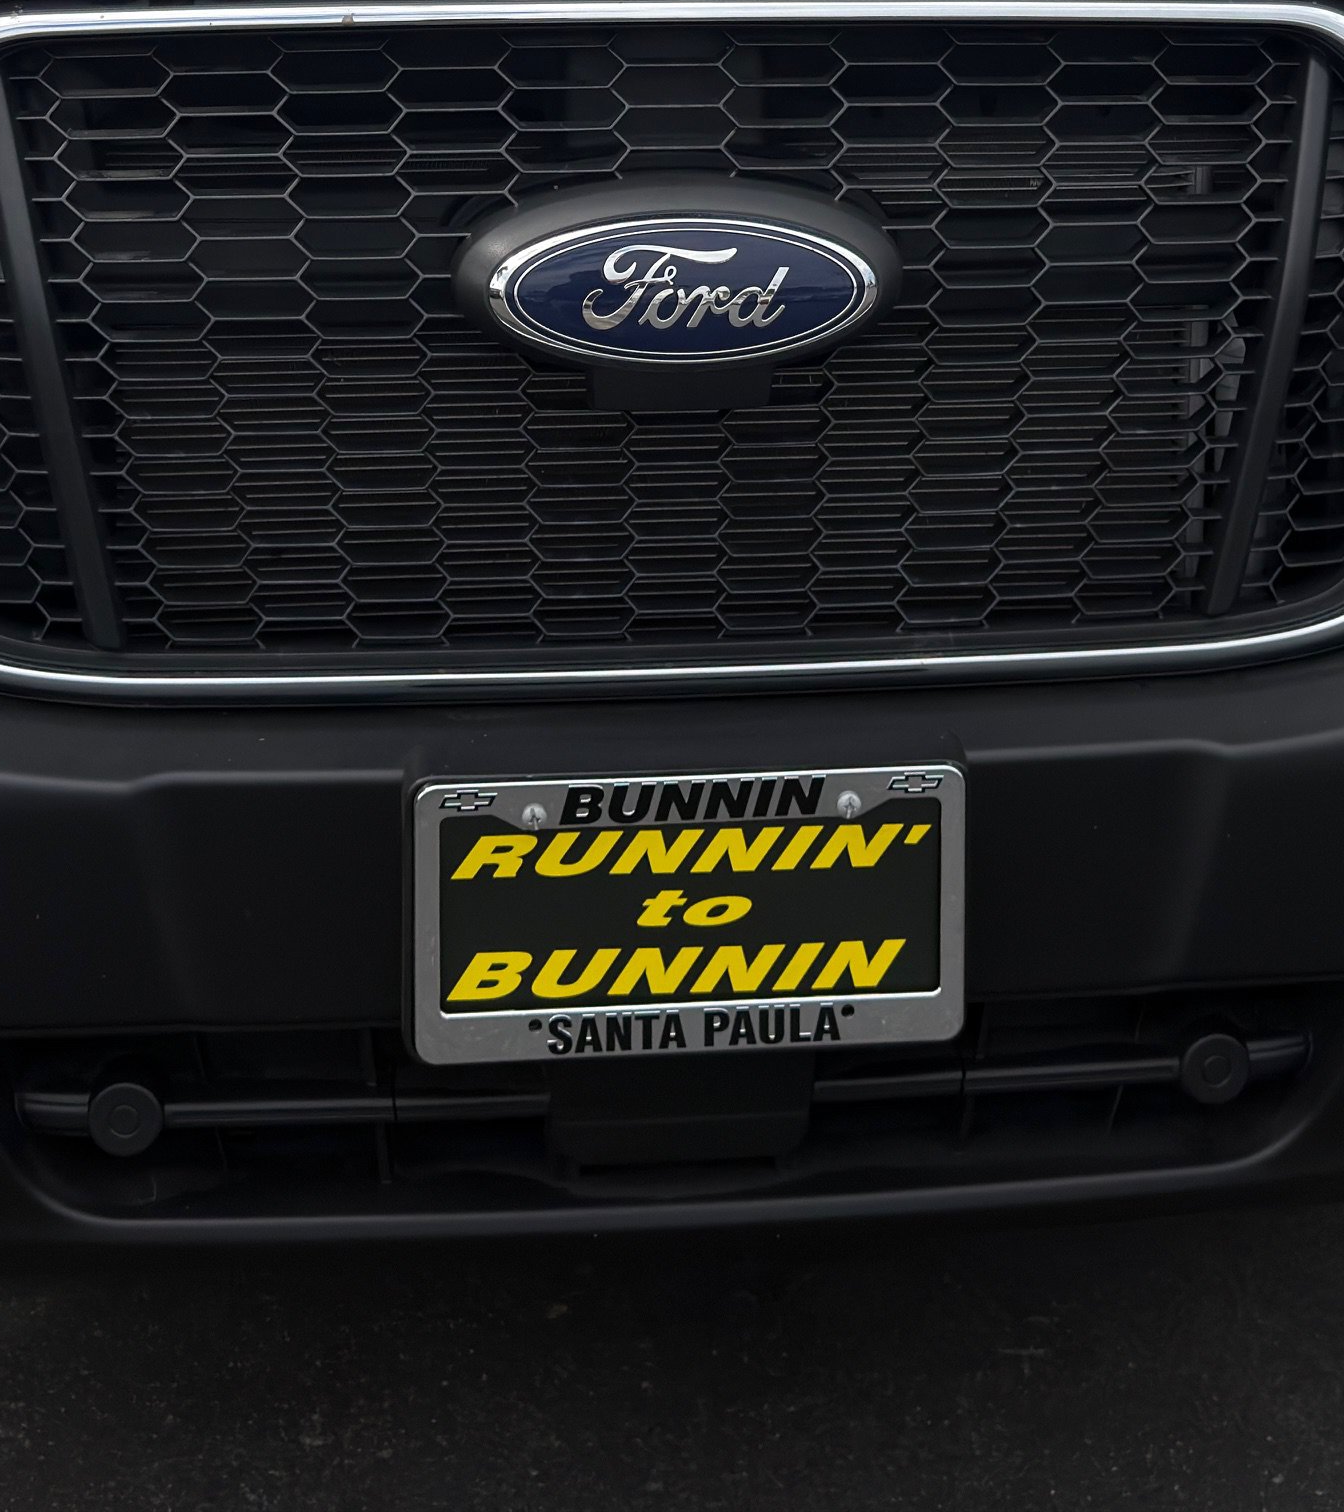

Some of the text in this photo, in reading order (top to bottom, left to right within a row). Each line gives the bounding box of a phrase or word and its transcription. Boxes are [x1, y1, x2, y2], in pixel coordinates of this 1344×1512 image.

[581, 243, 790, 331] Ford
[559, 774, 827, 827] BUNNIN
[450, 823, 932, 880] RUNNIN'
[636, 889, 753, 927] to
[446, 938, 907, 1002] BUNNIN
[546, 1002, 841, 1056] SANTA PAULA
